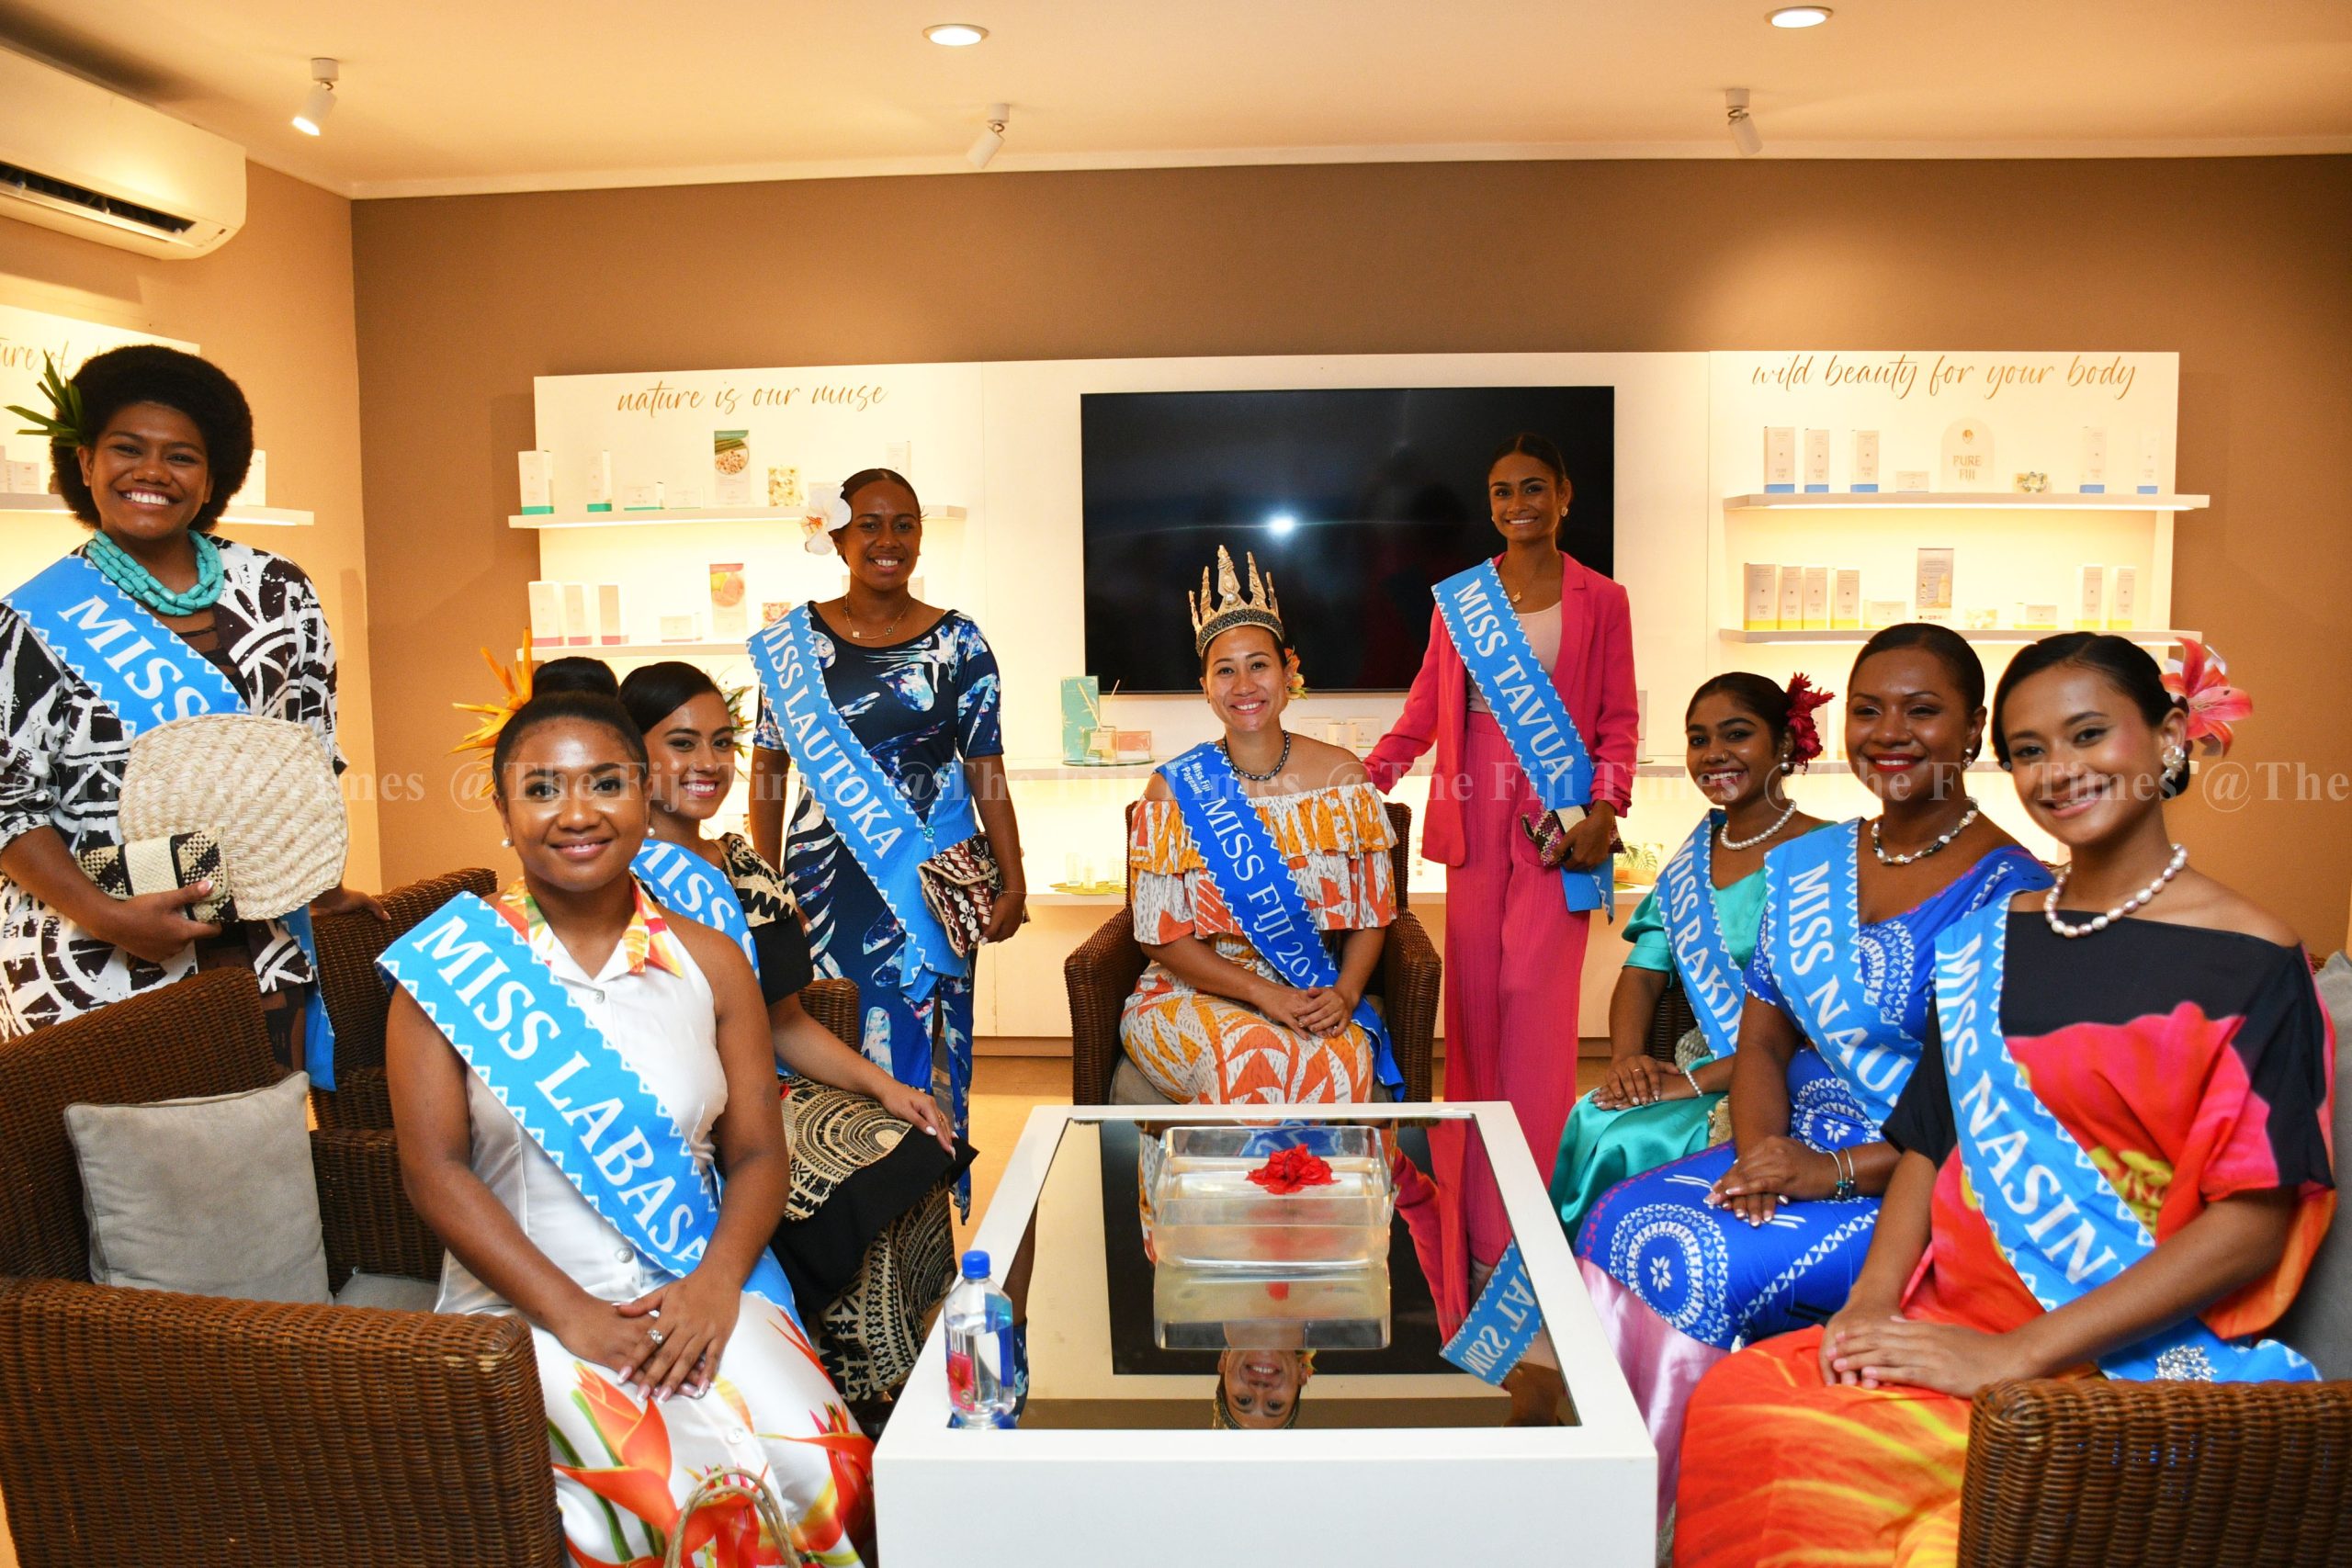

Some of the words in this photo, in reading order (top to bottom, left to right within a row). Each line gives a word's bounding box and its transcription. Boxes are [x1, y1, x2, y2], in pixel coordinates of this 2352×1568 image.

[0, 336, 40, 371] ure
[617, 379, 706, 418] nature
[715, 379, 742, 416] is
[752, 385, 800, 408] our
[811, 382, 888, 412] muse
[1752, 354, 1814, 393] wild
[1825, 354, 1917, 400] beauty
[1929, 354, 1974, 397] for
[1985, 364, 2054, 400] your
[2067, 354, 2137, 400] body
[1952, 455, 1982, 468] PURE
[57, 594, 210, 724] MISS
[1453, 579, 1508, 658] MISS
[1493, 654, 1575, 784] TAVUA
[785, 684, 903, 860] LAUTOKA
[1191, 762, 1204, 780] Miss
[1199, 795, 1265, 882] MISS
[1247, 882, 1295, 943] FIJI
[1668, 836, 1699, 923] MISS
[1788, 861, 1834, 976] MISS
[1806, 975, 1913, 1108] NAU
[1936, 932, 1982, 1077] MISS
[413, 915, 561, 1061] MISS
[536, 1050, 707, 1262] LABASA
[1958, 1070, 2126, 1285] NASIN
